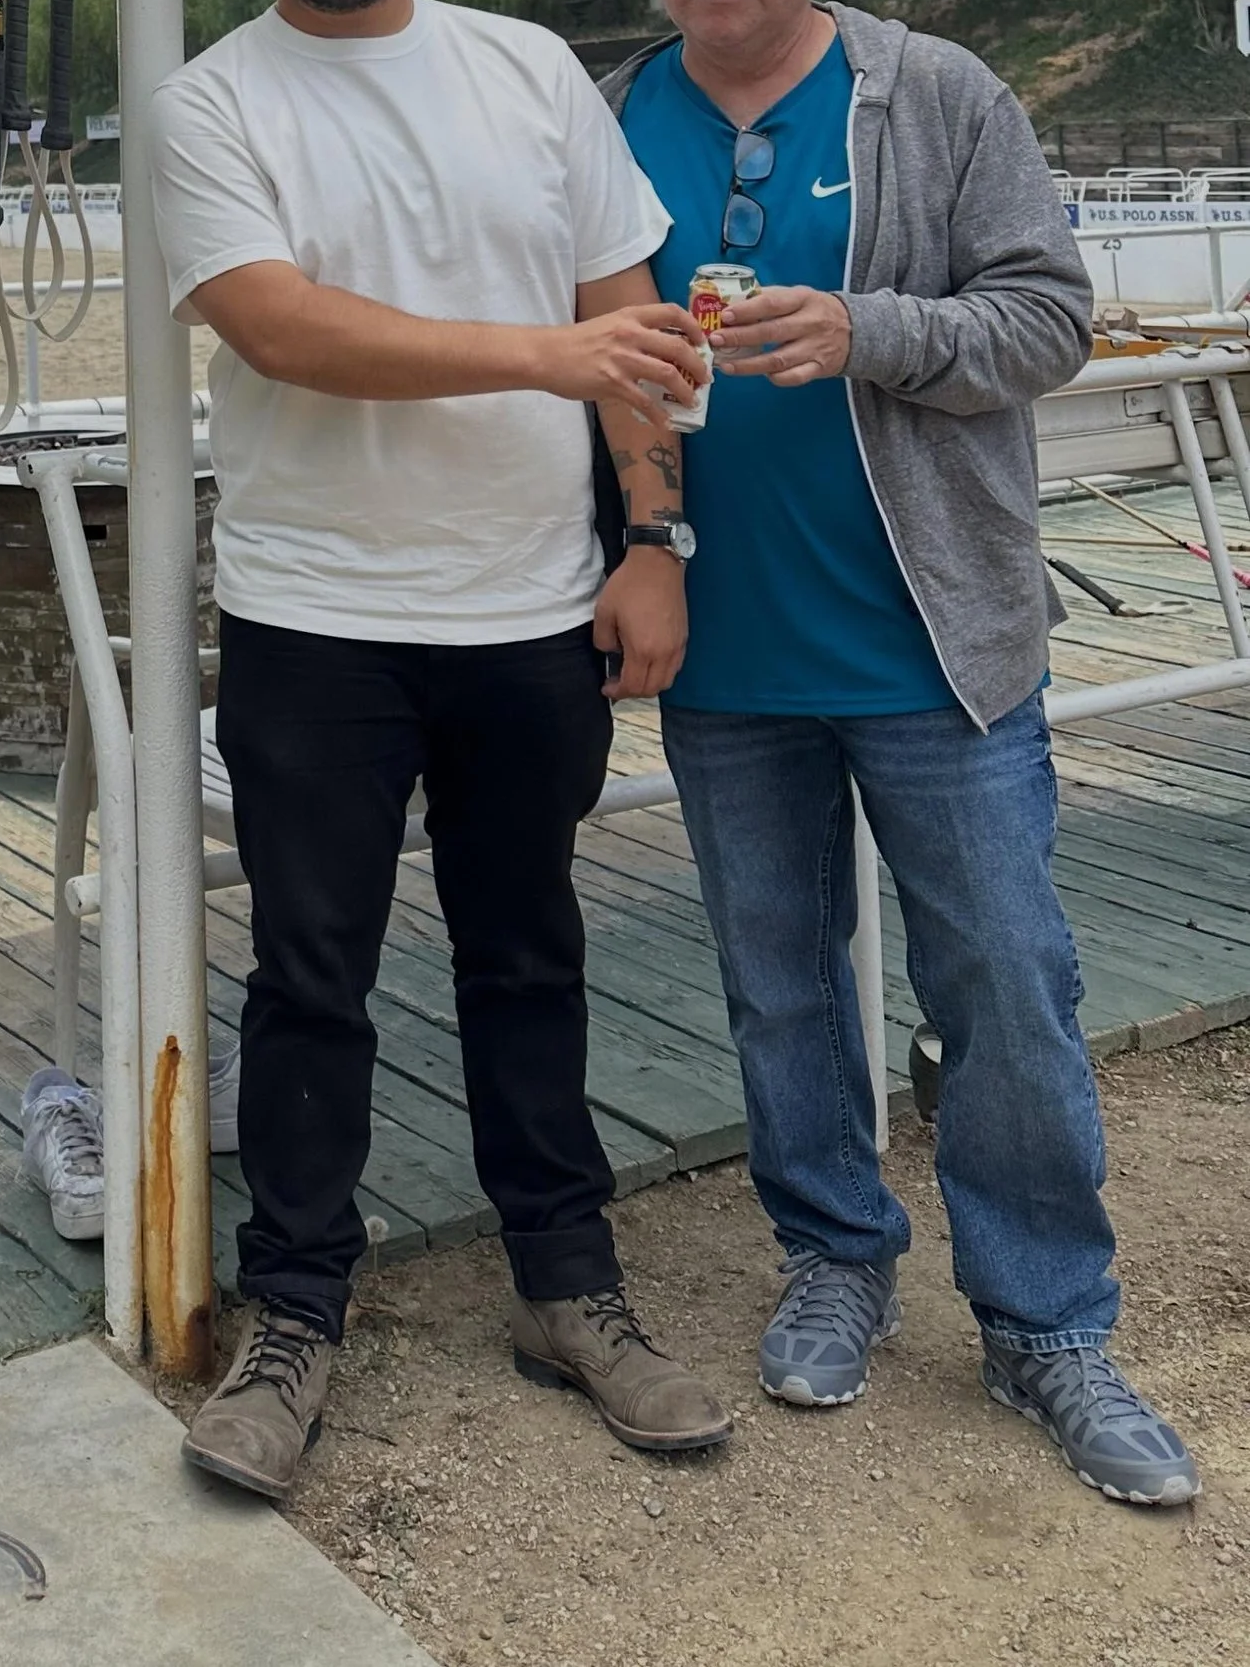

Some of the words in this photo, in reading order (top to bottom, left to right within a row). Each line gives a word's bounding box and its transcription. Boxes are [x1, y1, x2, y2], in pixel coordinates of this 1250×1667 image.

[1098, 210, 1118, 222] U.S.
[1122, 210, 1156, 222] POLO
[1159, 210, 1198, 222] ASSN.
[1221, 211, 1245, 223] U.S.
